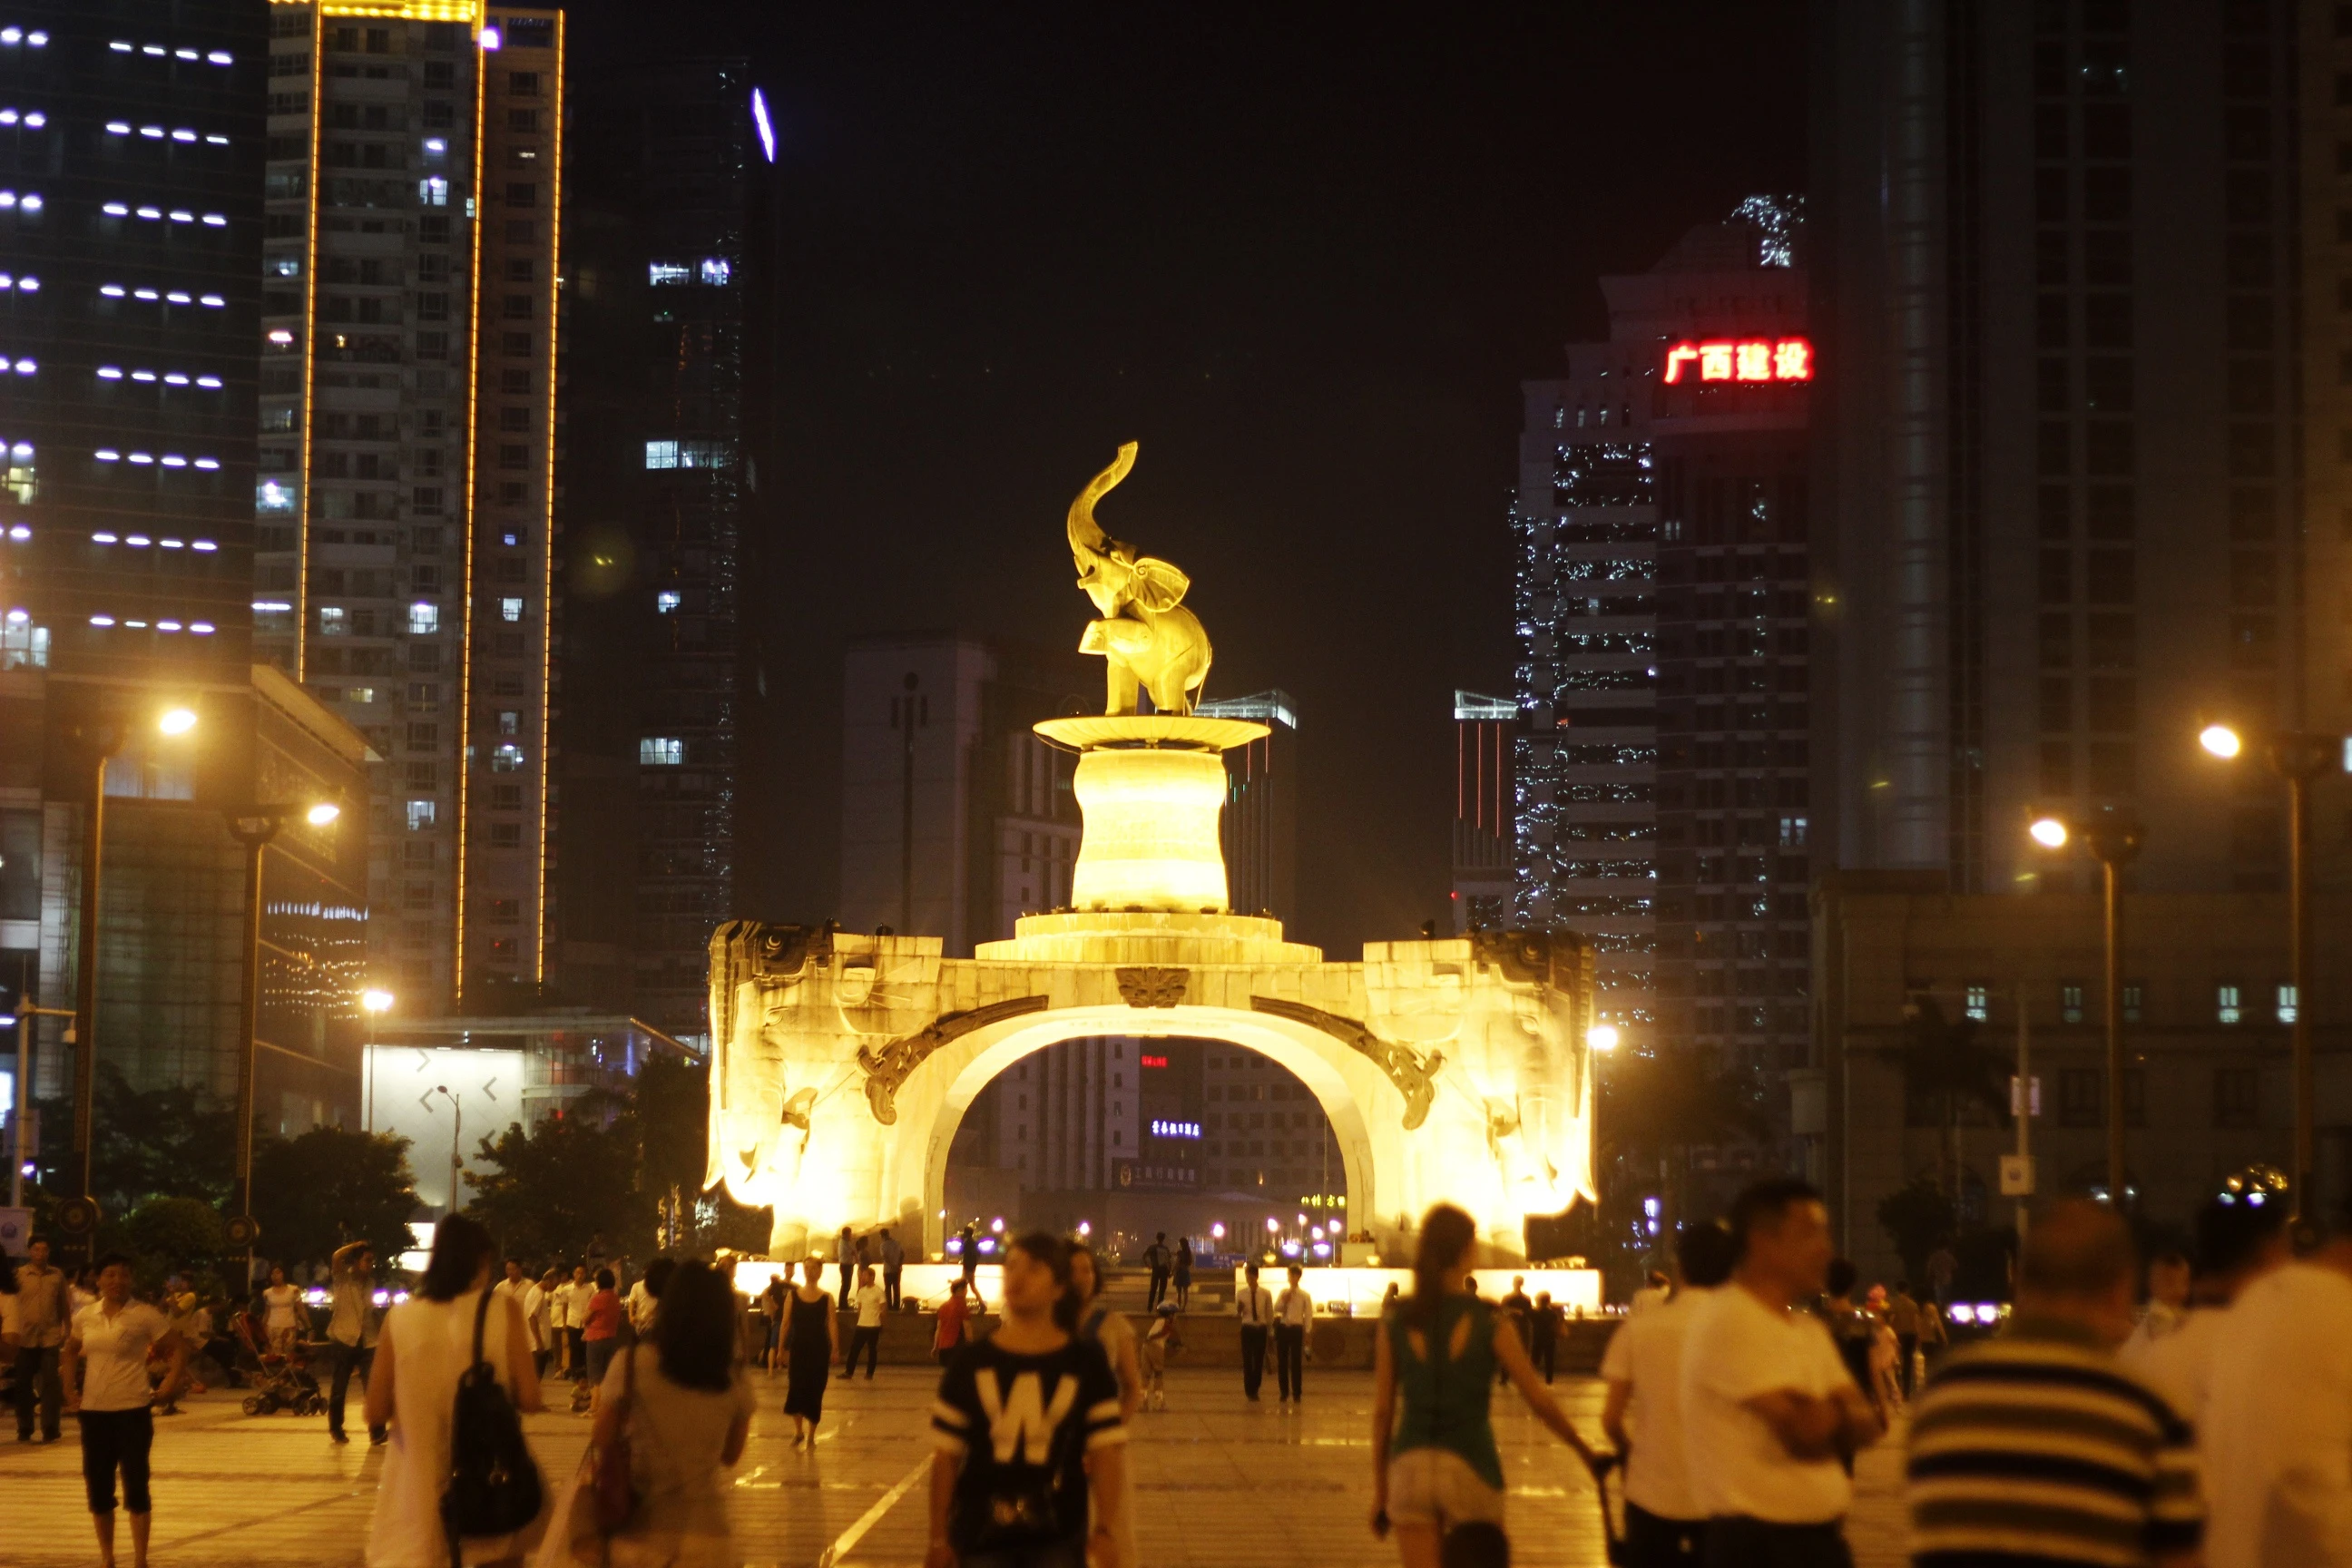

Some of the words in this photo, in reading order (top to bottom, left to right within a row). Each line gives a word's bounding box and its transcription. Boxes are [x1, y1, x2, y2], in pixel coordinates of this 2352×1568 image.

[1664, 341, 1808, 384] 广西建设
[974, 1366, 1080, 1465] W
